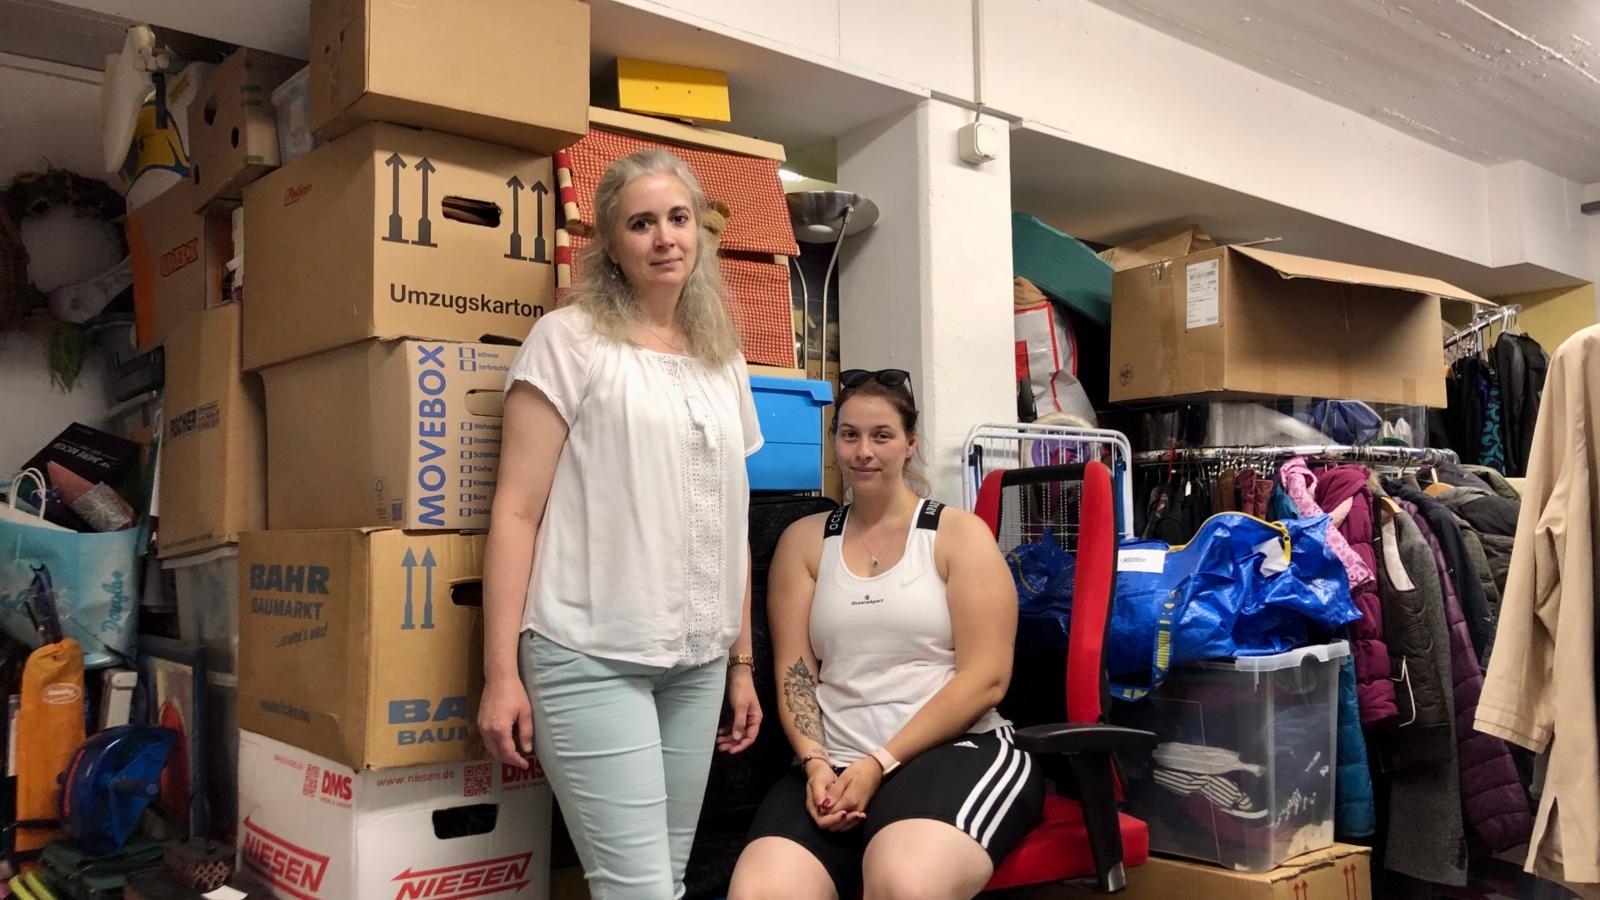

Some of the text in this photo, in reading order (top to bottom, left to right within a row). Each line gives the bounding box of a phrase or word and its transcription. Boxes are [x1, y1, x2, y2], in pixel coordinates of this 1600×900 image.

[390, 283, 544, 318] Umzugskarton
[418, 345, 446, 526] MOVEBOX
[250, 564, 330, 594] BAHR
[251, 597, 324, 620] BAUMARKT
[321, 770, 352, 801] DMS
[376, 769, 455, 787] www.niesen.de
[244, 832, 328, 893] NIESEN
[394, 858, 531, 900] NIESEN
